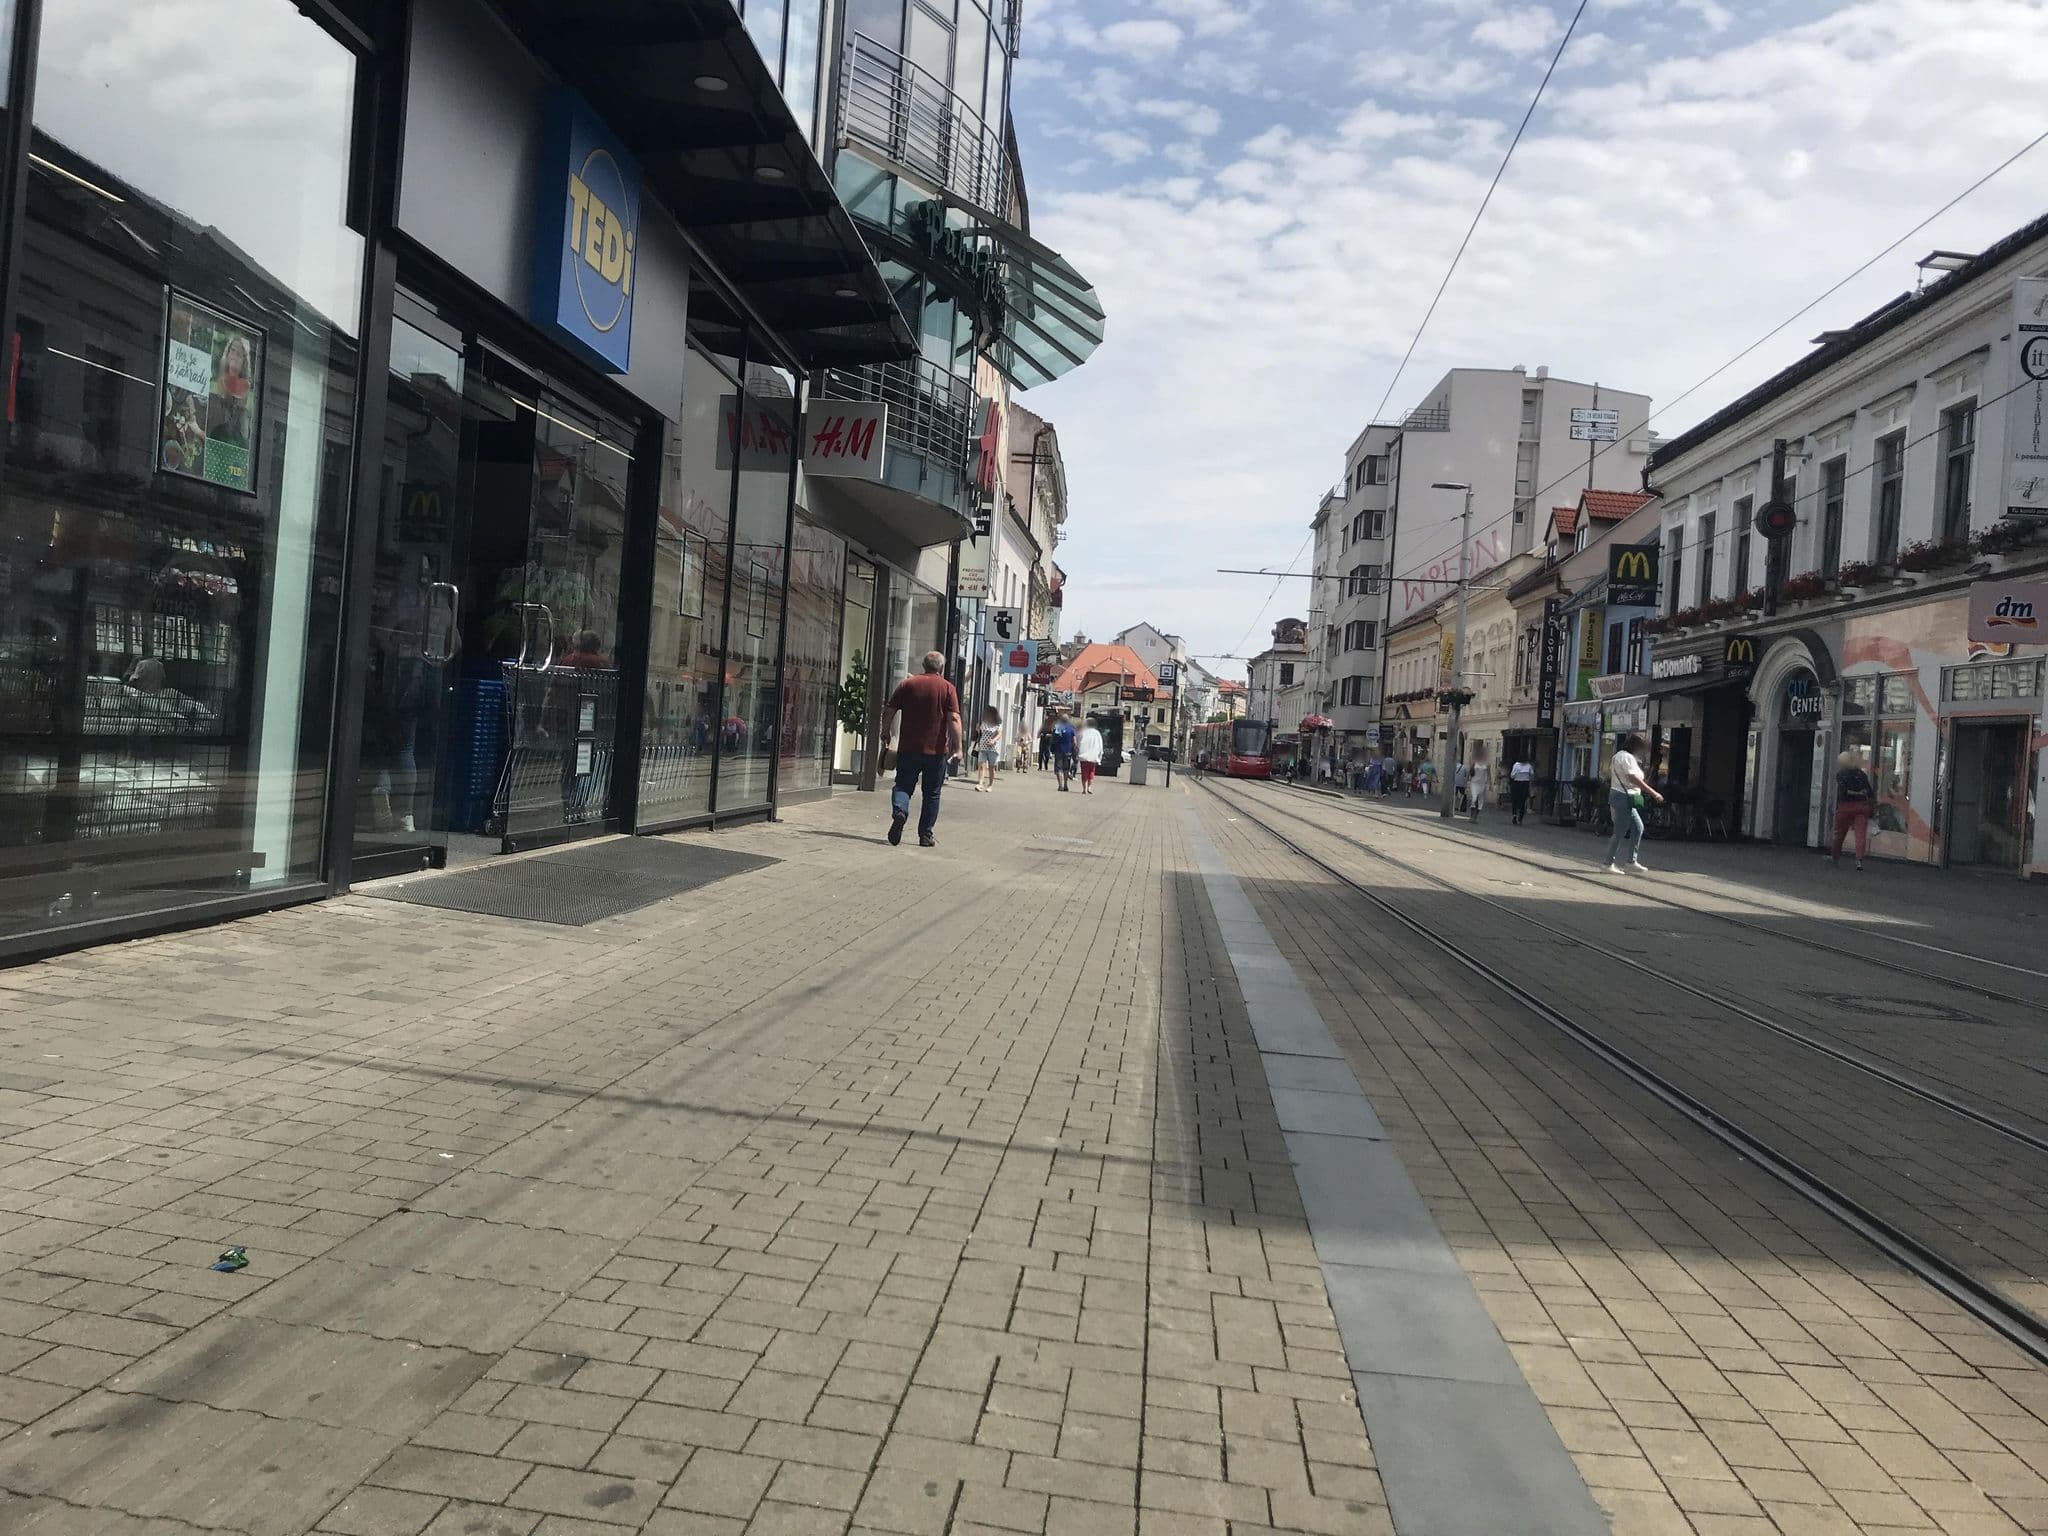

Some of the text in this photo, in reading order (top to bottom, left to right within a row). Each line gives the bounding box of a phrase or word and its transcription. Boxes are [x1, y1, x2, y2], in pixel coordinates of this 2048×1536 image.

[570, 172, 633, 297] TEDi
[812, 416, 878, 461] H&M
[1996, 596, 2033, 617] dm
[1546, 616, 1559, 673] Slovak
[1652, 653, 1698, 680] McDonald's
[1543, 680, 1552, 710] pub
